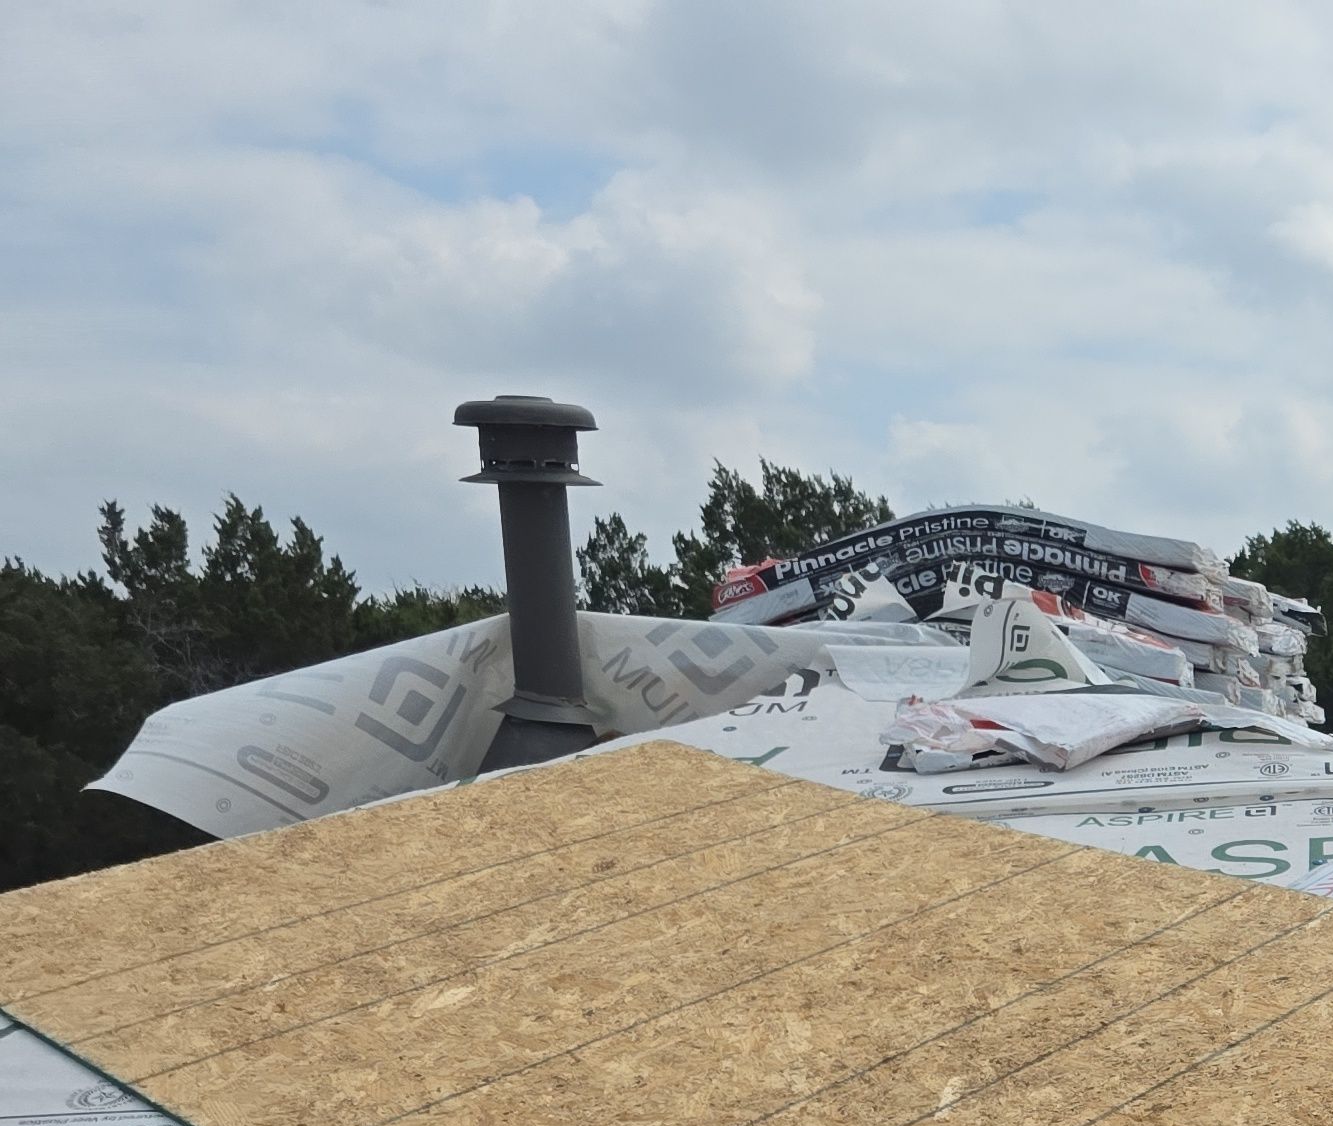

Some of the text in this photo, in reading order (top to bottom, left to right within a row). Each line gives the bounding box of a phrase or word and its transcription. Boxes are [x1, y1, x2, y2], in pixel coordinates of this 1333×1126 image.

[774, 516, 989, 580] Pinnacle Pristine
[1003, 539, 1127, 583] Pinnacle
[1092, 586, 1122, 603] OK
[1075, 807, 1236, 828] ASPIRE
